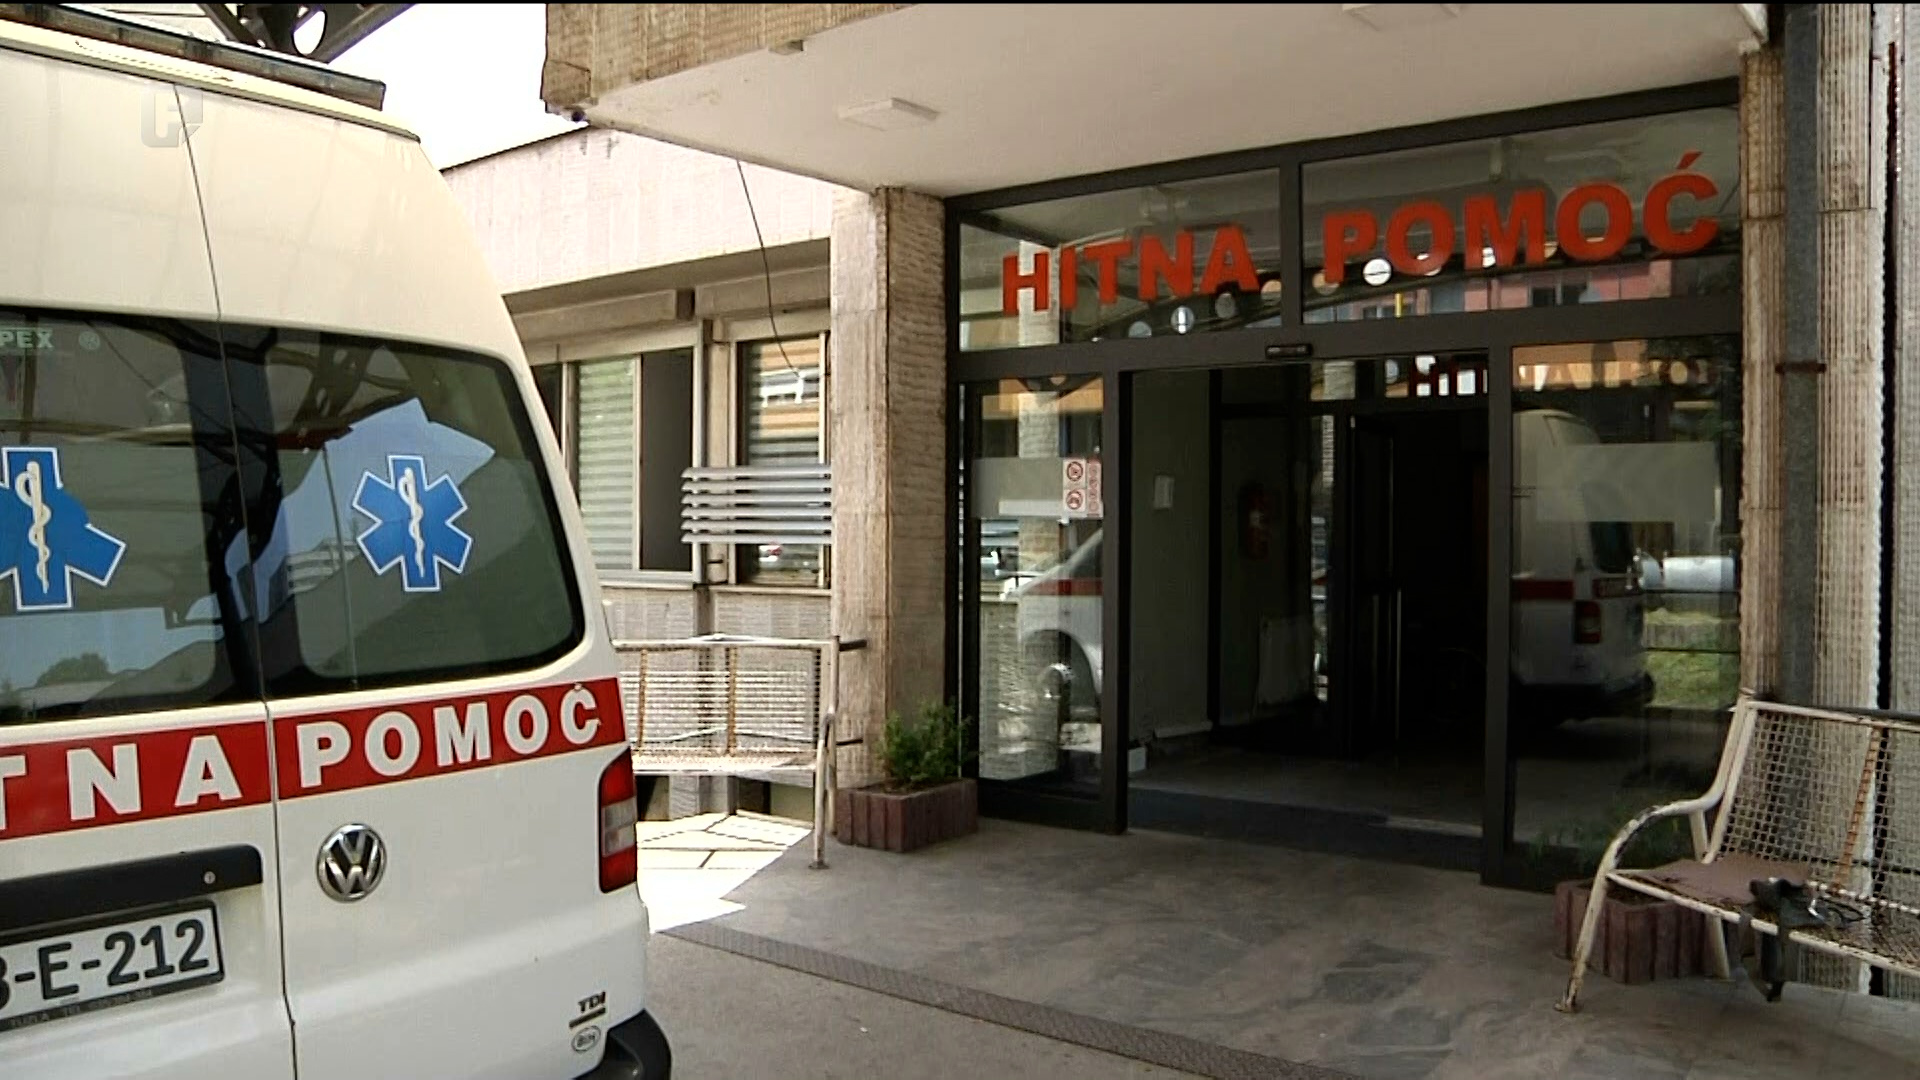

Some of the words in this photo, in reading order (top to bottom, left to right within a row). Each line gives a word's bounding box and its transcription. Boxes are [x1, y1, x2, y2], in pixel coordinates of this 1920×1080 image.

[1003, 223, 1257, 317] HITNA
[1323, 151, 1720, 286] POMOĆ
[578, 991, 606, 1012] TDI
